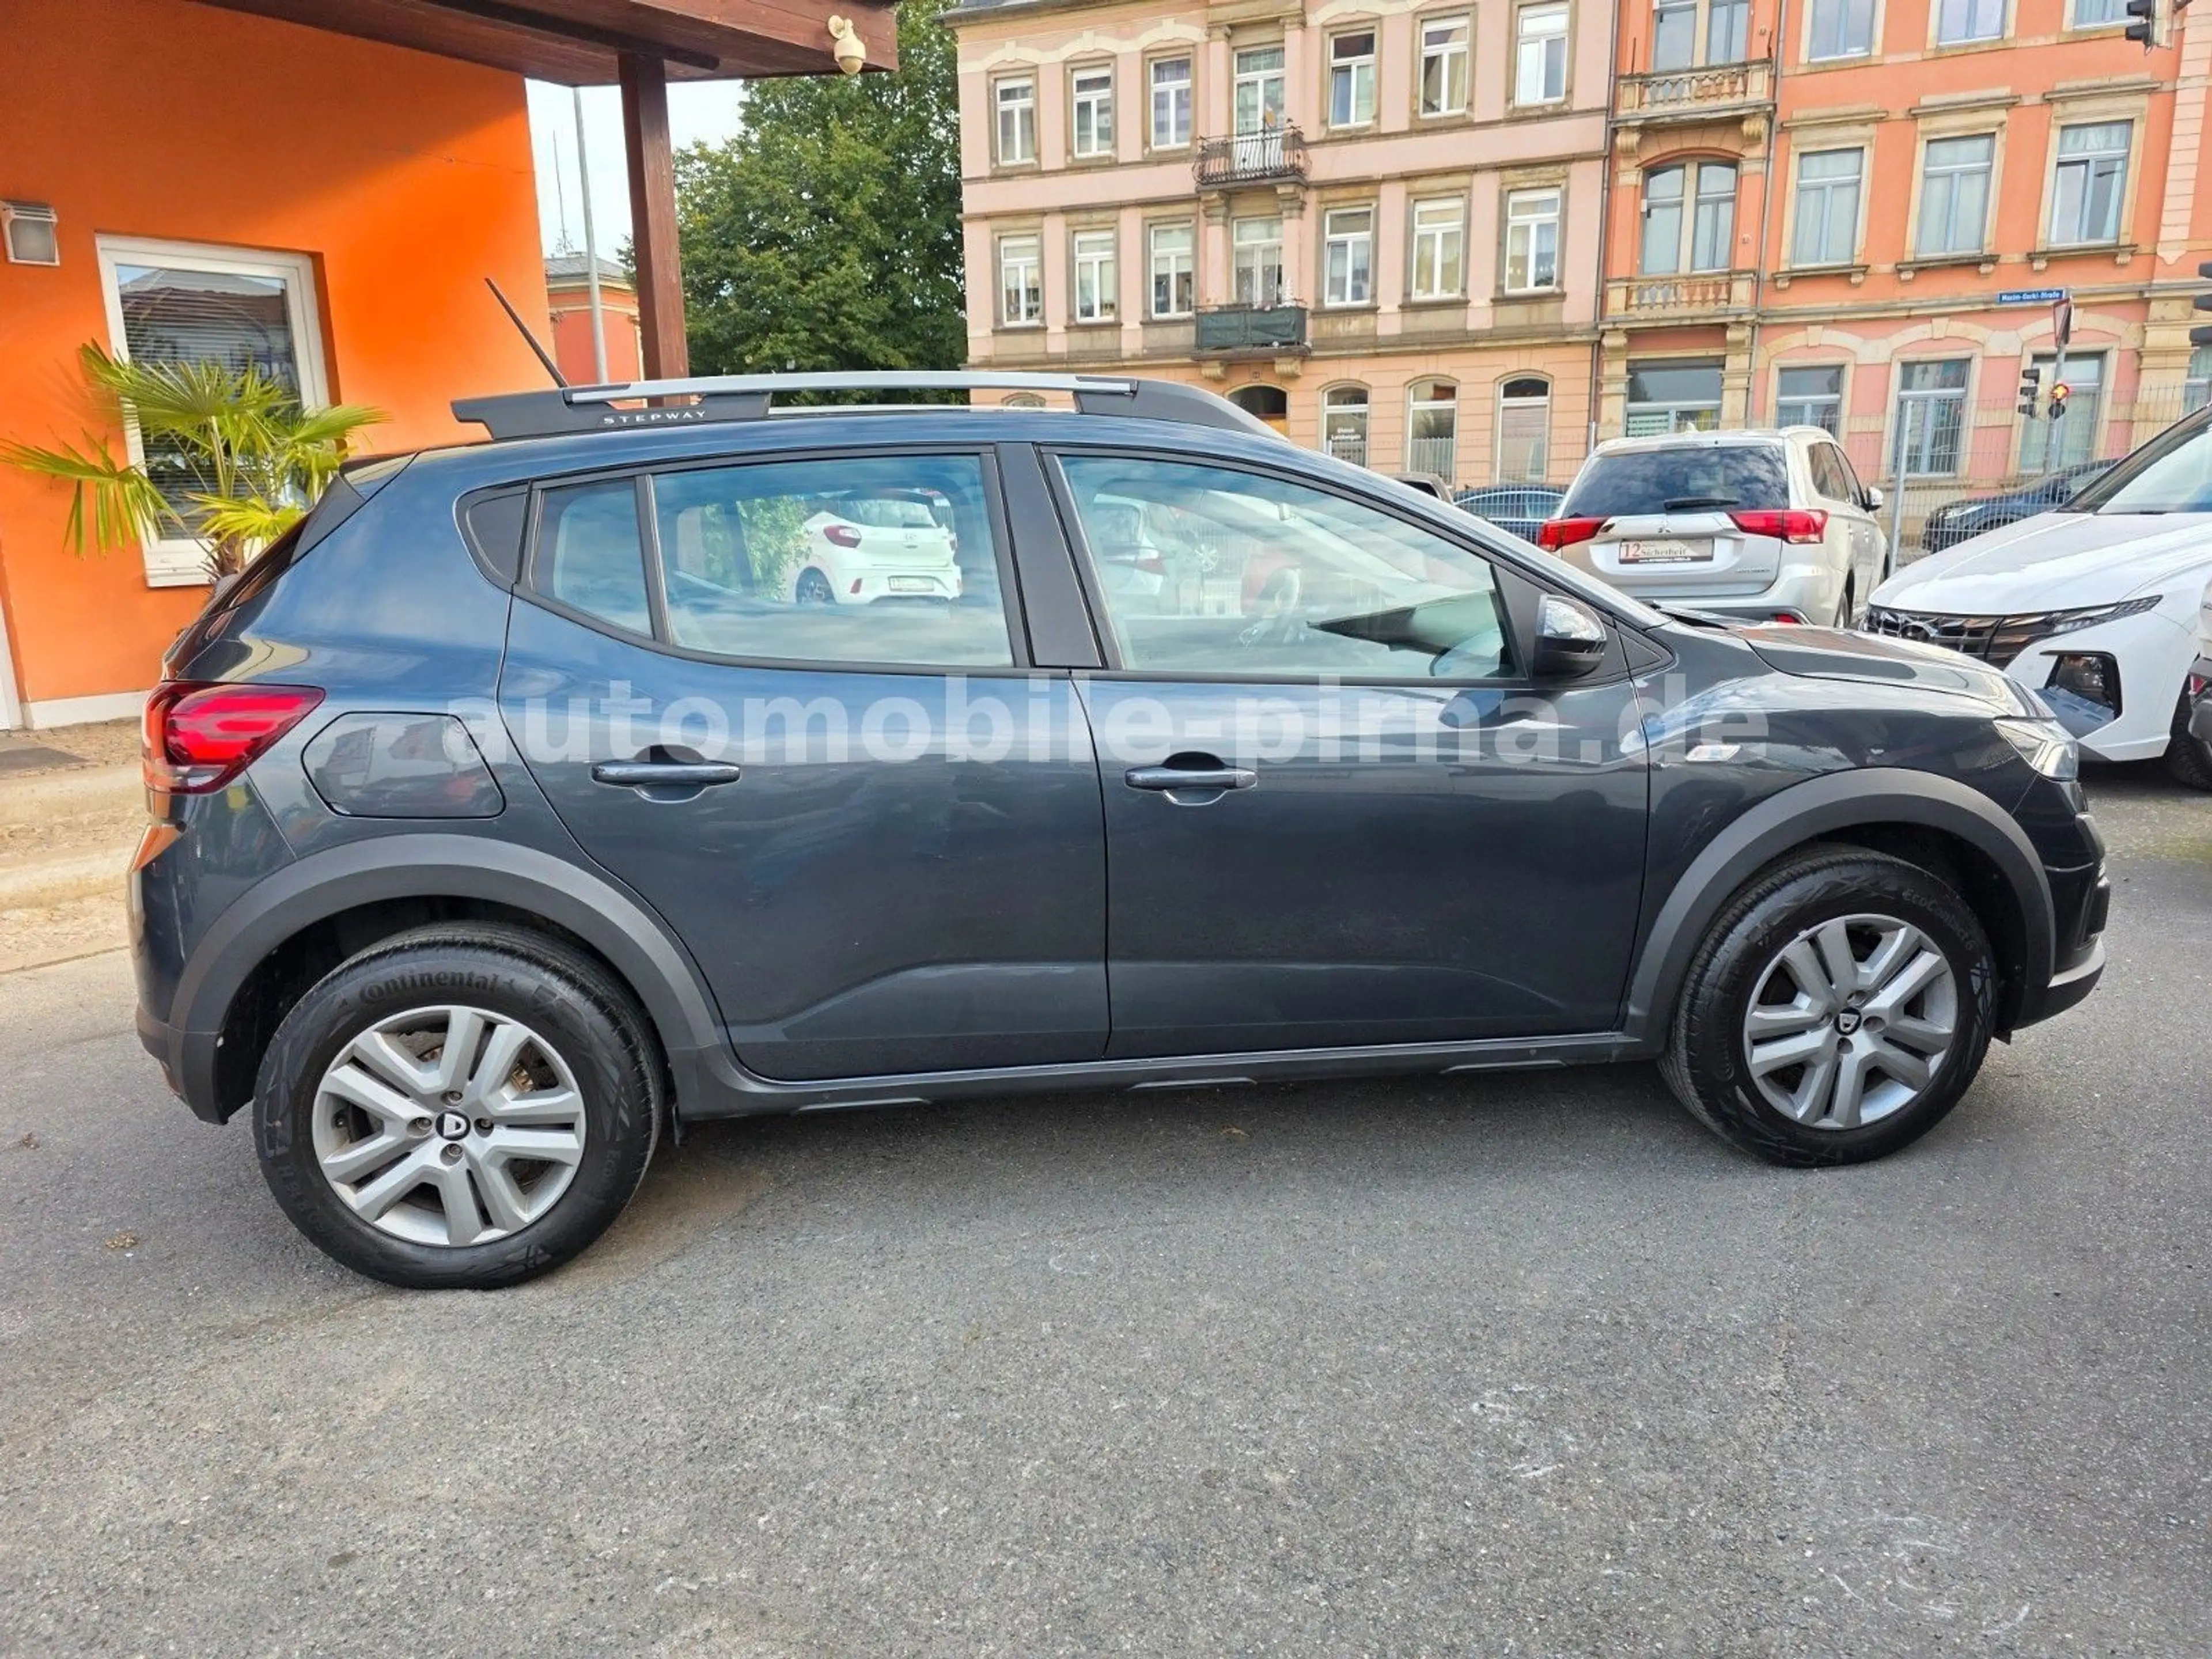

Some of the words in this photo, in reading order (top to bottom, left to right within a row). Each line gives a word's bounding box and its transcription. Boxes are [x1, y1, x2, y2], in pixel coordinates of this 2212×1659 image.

[604, 410, 706, 424] STEPWAY
[1624, 543, 1641, 557] 12
[359, 971, 499, 1003] Continental
